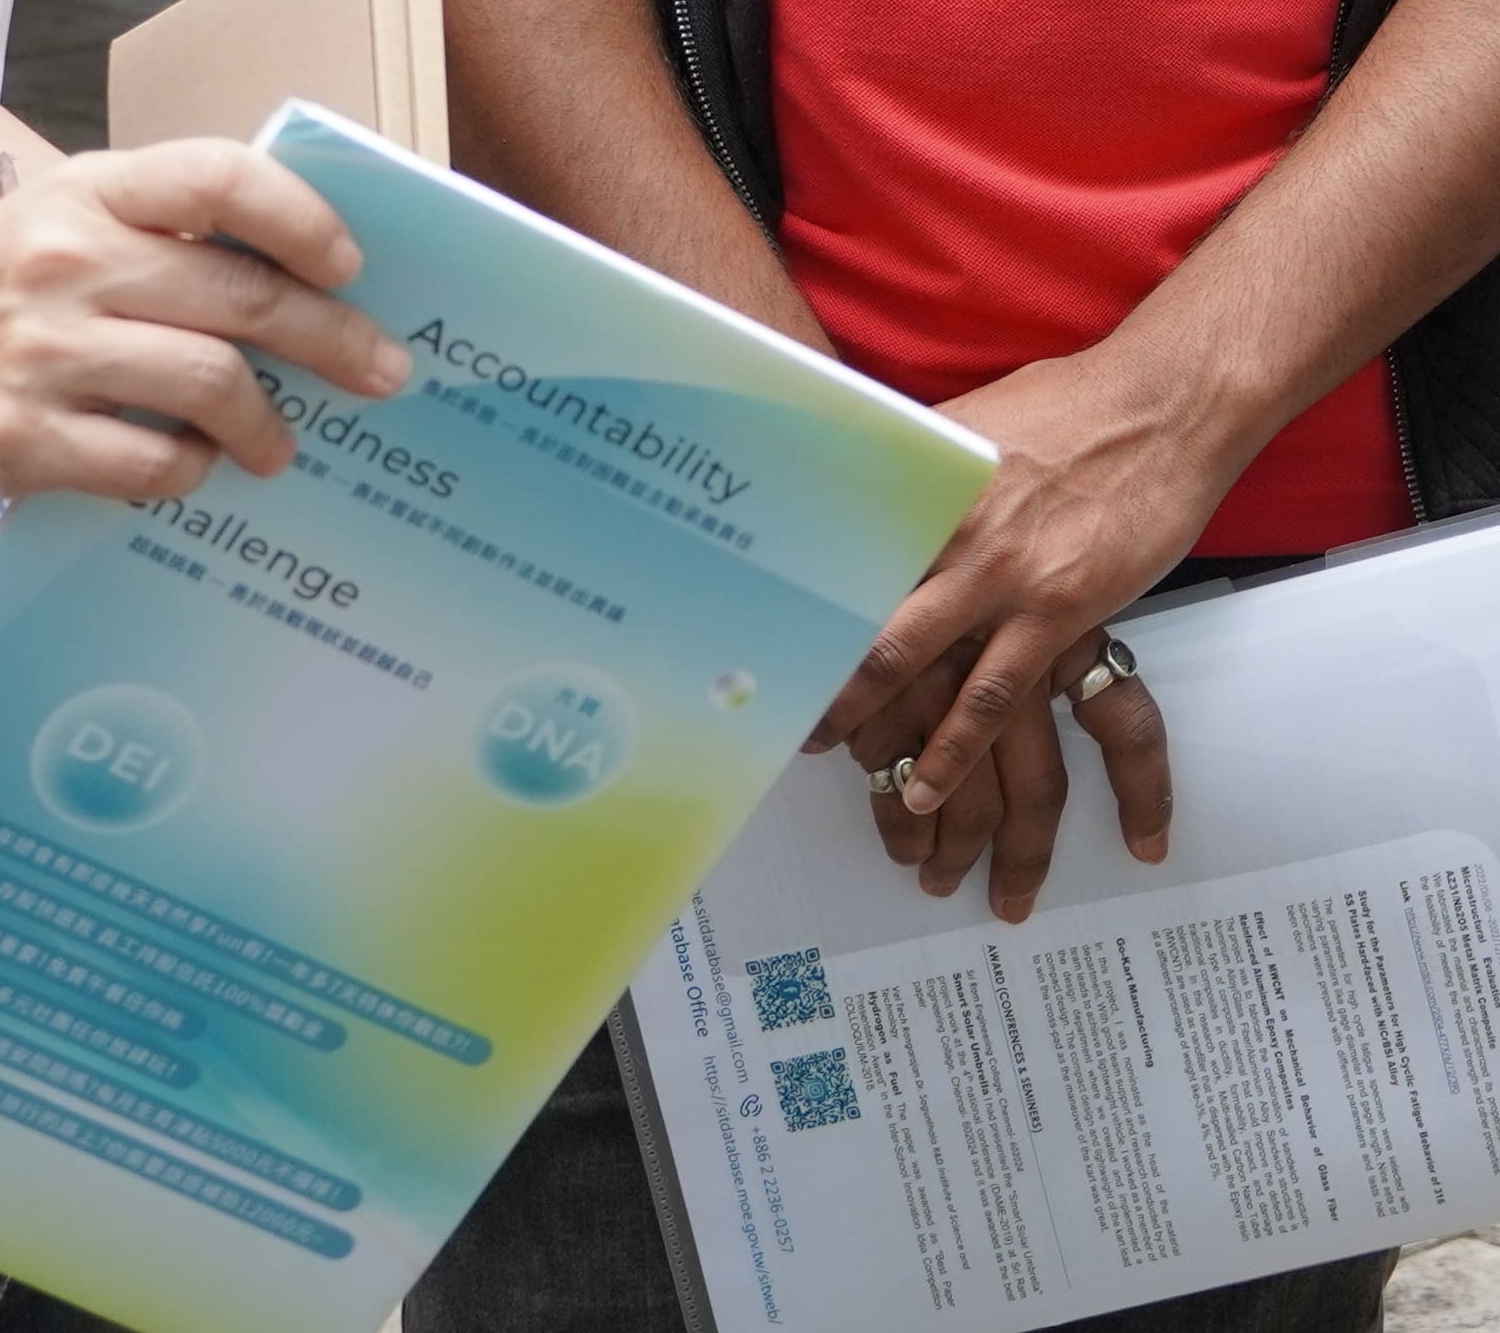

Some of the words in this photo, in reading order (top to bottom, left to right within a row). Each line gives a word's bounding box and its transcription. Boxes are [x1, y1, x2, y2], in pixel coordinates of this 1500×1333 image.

[407, 316, 752, 505] Accountability
[127, 497, 360, 611] hallenge
[66, 722, 177, 793] DEI
[490, 700, 606, 781] DNA
[1357, 890, 1372, 918] Study
[1460, 865, 1488, 944] Microstructural
[1253, 910, 1269, 941] Effect
[1365, 920, 1376, 935] for
[1369, 936, 1380, 953] the
[986, 944, 1005, 985] AWARD
[1262, 946, 1274, 957] of
[1267, 963, 1285, 1001] MWCNT
[1374, 955, 1395, 1012] Parameters
[1116, 937, 1135, 982] Go-Kart
[1127, 983, 1155, 1069] Manufacturing
[1238, 913, 1261, 966] Reinforced
[1252, 967, 1271, 1017] Aluminum
[1265, 1017, 1280, 1049] Epoxy
[1273, 1050, 1294, 1111] Composites
[1279, 1008, 1288, 1022] on
[1389, 1013, 1400, 1028] for
[867, 990, 888, 1045] Hydrogen
[883, 1051, 893, 1065] as
[888, 1071, 903, 1096] Fuel
[952, 972, 969, 1009] Smart
[961, 1009, 976, 1041] Solar
[970, 1041, 990, 1096] Umbrella
[1393, 1030, 1407, 1054] High
[1017, 1066, 1028, 1075] &
[1284, 1028, 1307, 1088] Mechanical
[1399, 1055, 1415, 1088] Cyclic
[1020, 1076, 1044, 1134] SEMINERS)
[1300, 1094, 1317, 1139] Behavior
[1408, 1089, 1424, 1129] Fatigue
[686, 985, 709, 1038] Office
[700, 1054, 782, 1324] https://sitdatabase.moe.gov.tw/sitweb/
[750, 1124, 772, 1162] +886
[1313, 1146, 1324, 1157] of
[1419, 1130, 1436, 1174] Behavior
[759, 1164, 774, 1175] 2
[1317, 1163, 1331, 1192] Glass
[1430, 1176, 1442, 1186] of
[762, 1176, 793, 1255] 2236-0257
[1326, 1197, 1339, 1222] Fiber
[1433, 1187, 1446, 1205] 316
